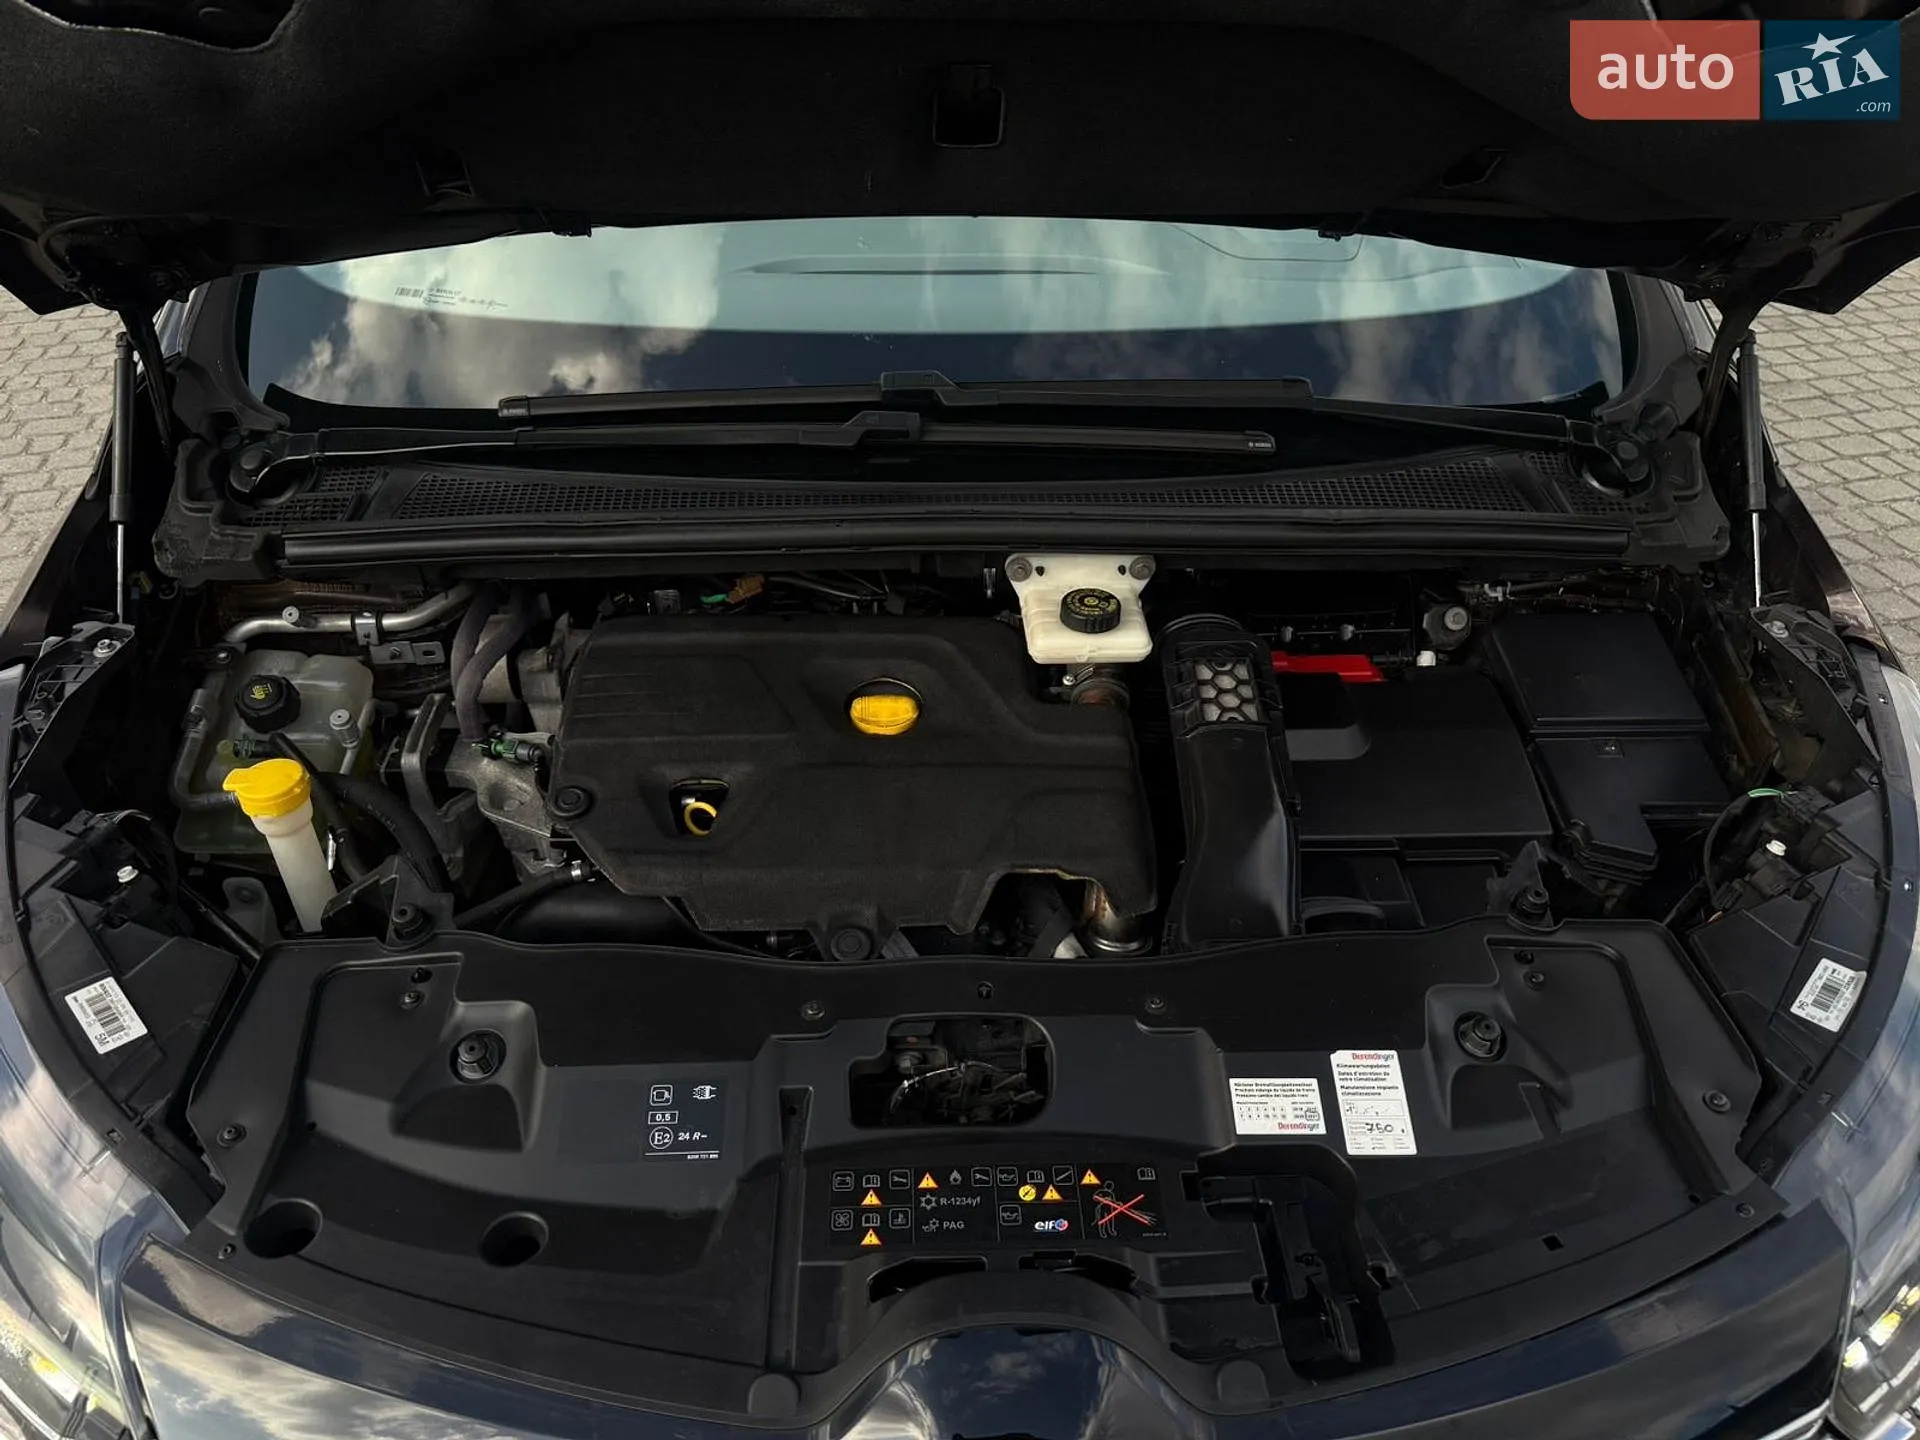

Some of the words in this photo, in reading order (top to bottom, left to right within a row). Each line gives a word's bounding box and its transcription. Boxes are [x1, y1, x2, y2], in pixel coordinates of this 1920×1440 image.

[656, 1114, 670, 1122] 0,5
[678, 1132, 690, 1140] 24
[940, 1197, 980, 1207] R-1234yf
[943, 1221, 964, 1230] PAG
[1034, 1220, 1056, 1230] elf
